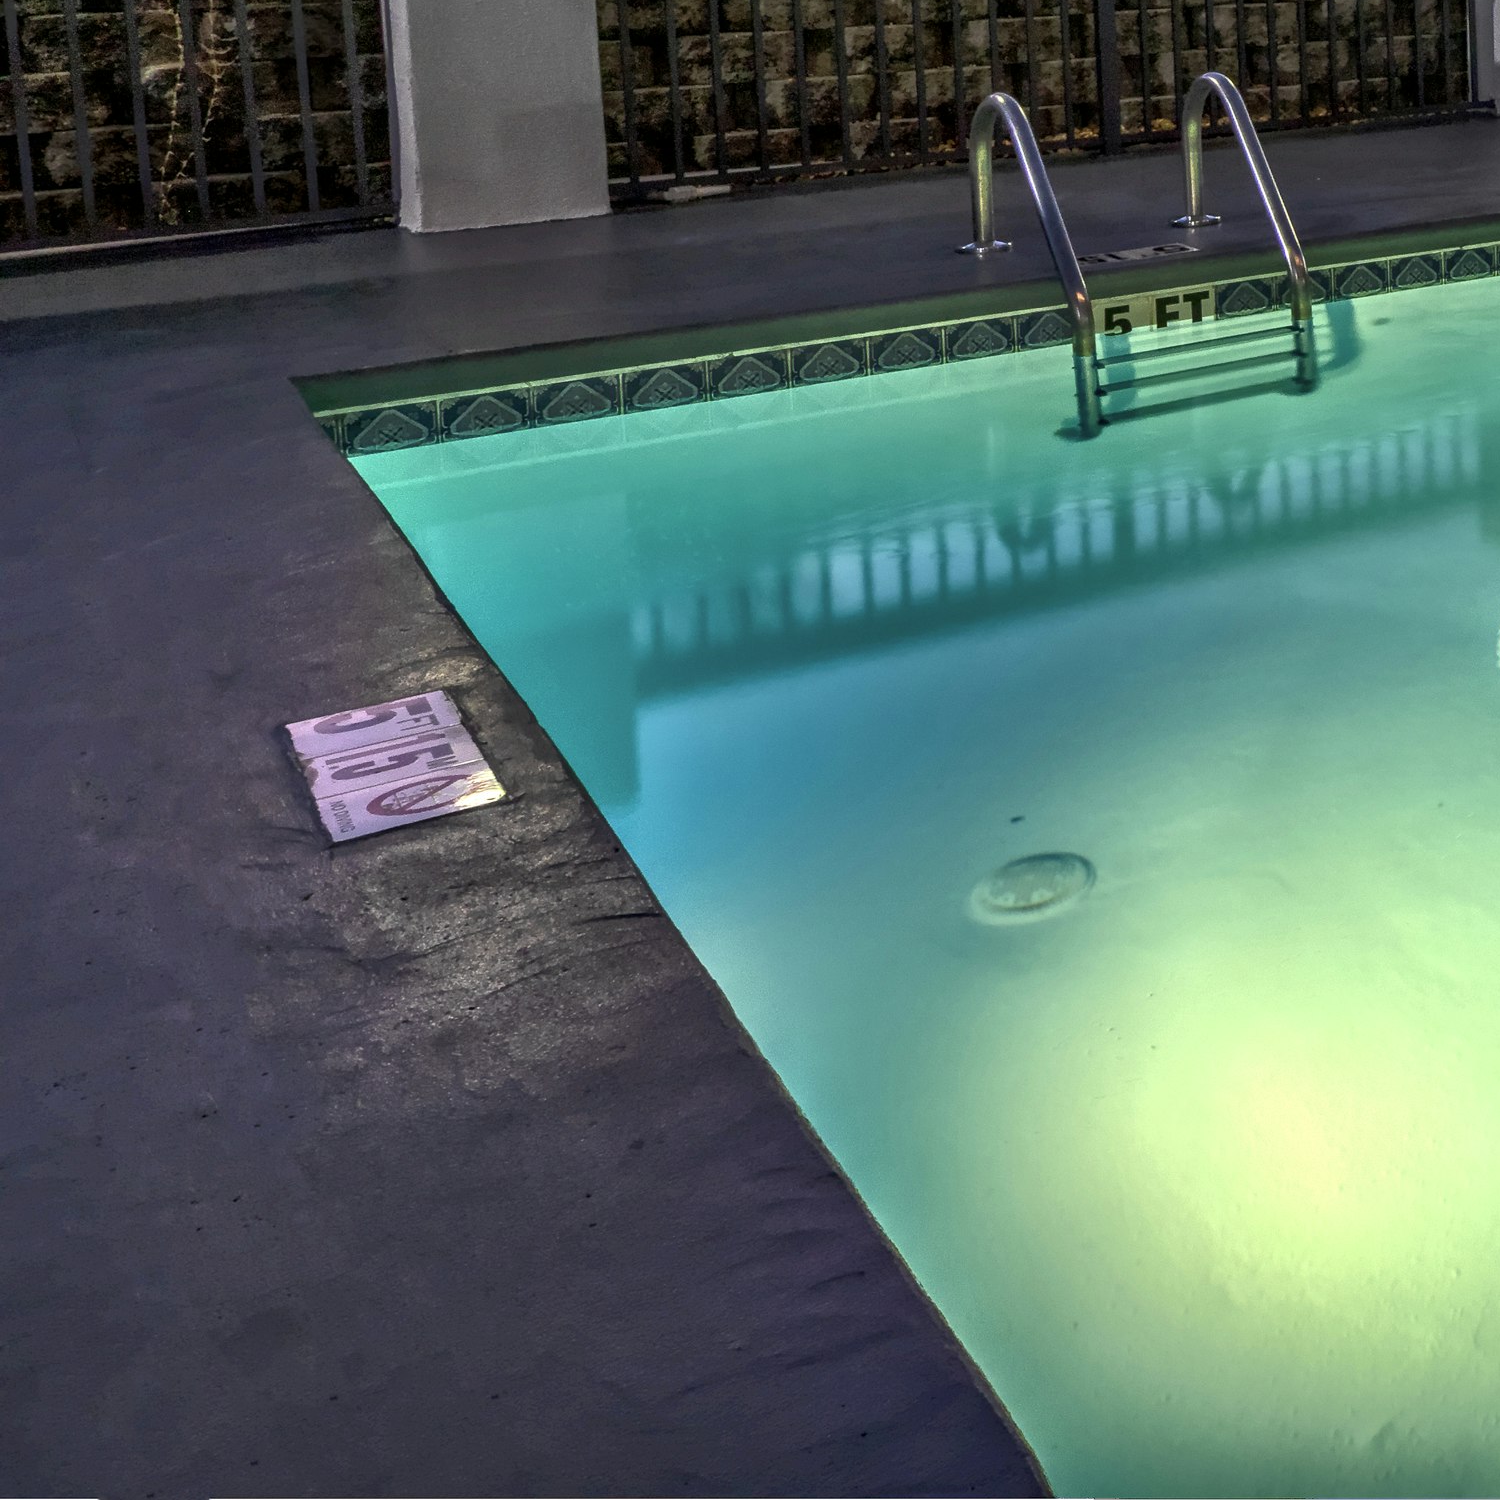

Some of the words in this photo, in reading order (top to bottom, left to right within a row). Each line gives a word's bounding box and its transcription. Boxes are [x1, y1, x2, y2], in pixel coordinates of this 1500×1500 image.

[1104, 304, 1132, 336] 5
[1155, 290, 1210, 328] FT
[313, 697, 433, 735] 5
[397, 713, 440, 731] FT
[427, 755, 459, 770] M
[330, 800, 346, 811] NO
